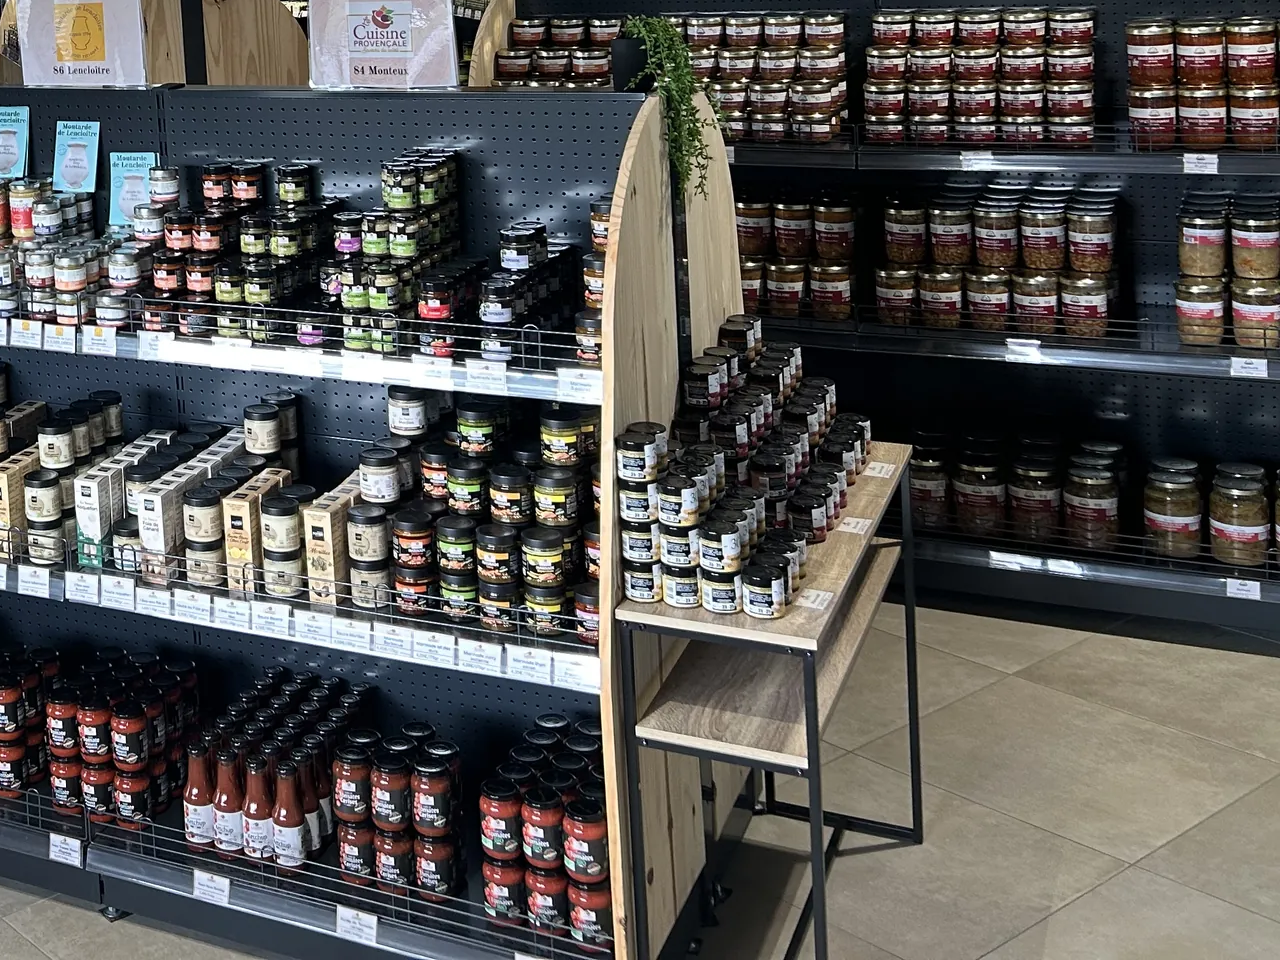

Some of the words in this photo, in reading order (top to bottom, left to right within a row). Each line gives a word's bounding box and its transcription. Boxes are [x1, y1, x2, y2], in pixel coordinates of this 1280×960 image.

[353, 25, 407, 40] Cuisine
[353, 40, 408, 48] PROVENÇALE
[53, 66, 64, 75] 86
[68, 65, 111, 75] Lencloître
[353, 66, 365, 75] 84
[368, 65, 409, 75] Monteux
[62, 122, 92, 130] Moutarde
